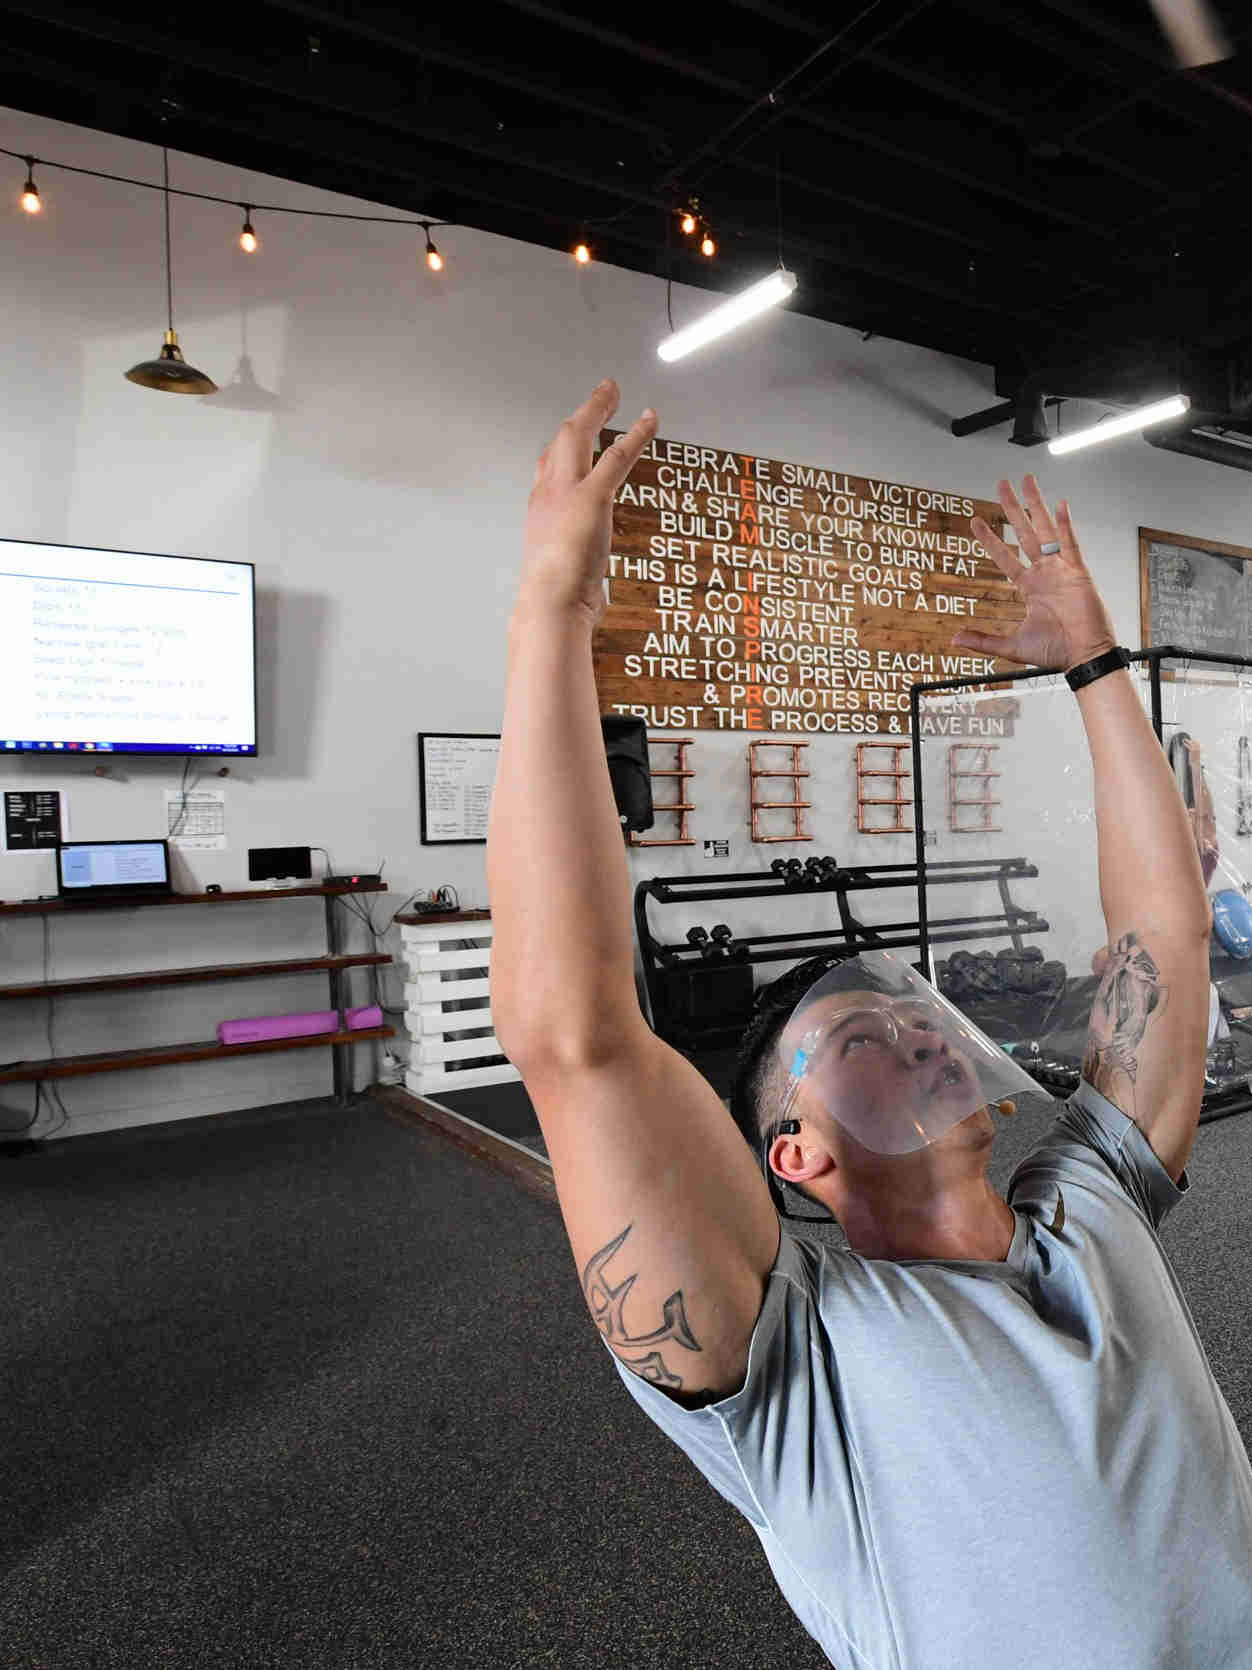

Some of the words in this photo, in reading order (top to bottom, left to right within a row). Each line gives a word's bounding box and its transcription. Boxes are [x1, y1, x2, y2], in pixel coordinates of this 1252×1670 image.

[614, 433, 771, 481] LEBRATE
[781, 463, 857, 497] SMALL
[868, 480, 975, 518] VICTORIES
[657, 465, 805, 509] CHALLENGE
[816, 491, 929, 529] YOURSELF
[613, 482, 677, 511] ARN
[681, 492, 699, 515] &
[706, 496, 791, 529] SHARE
[800, 511, 865, 541] YOUR
[871, 524, 992, 560] KNOWLEDG
[660, 511, 733, 542] BUILD
[740, 523, 834, 556] MUSCLE
[842, 539, 873, 562] TO
[880, 546, 936, 572] BURN
[942, 555, 980, 577] FAT
[608, 554, 667, 583] THIS
[674, 562, 698, 586] IS
[706, 567, 726, 590] A
[733, 570, 856, 604] LIFESTYLE
[863, 585, 907, 609] NOT
[914, 593, 929, 612] A
[935, 594, 978, 617] DIET
[649, 535, 701, 562] SET
[712, 543, 839, 579] REALISTIC
[848, 563, 923, 591] GOALS
[655, 608, 736, 635] TRAIN
[743, 615, 859, 648] SMARTER
[658, 585, 695, 610] BE
[704, 590, 855, 625] CONSISTENT
[623, 654, 790, 685] STRETCHING
[799, 665, 915, 692] PREVENTS
[643, 632, 691, 656] AIM
[699, 636, 737, 659] TO
[745, 640, 872, 669] PROGRESS
[877, 651, 934, 673] EACH
[940, 655, 997, 676] WEEK
[703, 683, 721, 704] &
[730, 684, 861, 711] PROMOTES
[712, 706, 764, 730] THE
[770, 710, 880, 734] PROCESS
[888, 715, 902, 734] &
[967, 716, 1004, 735] FUN
